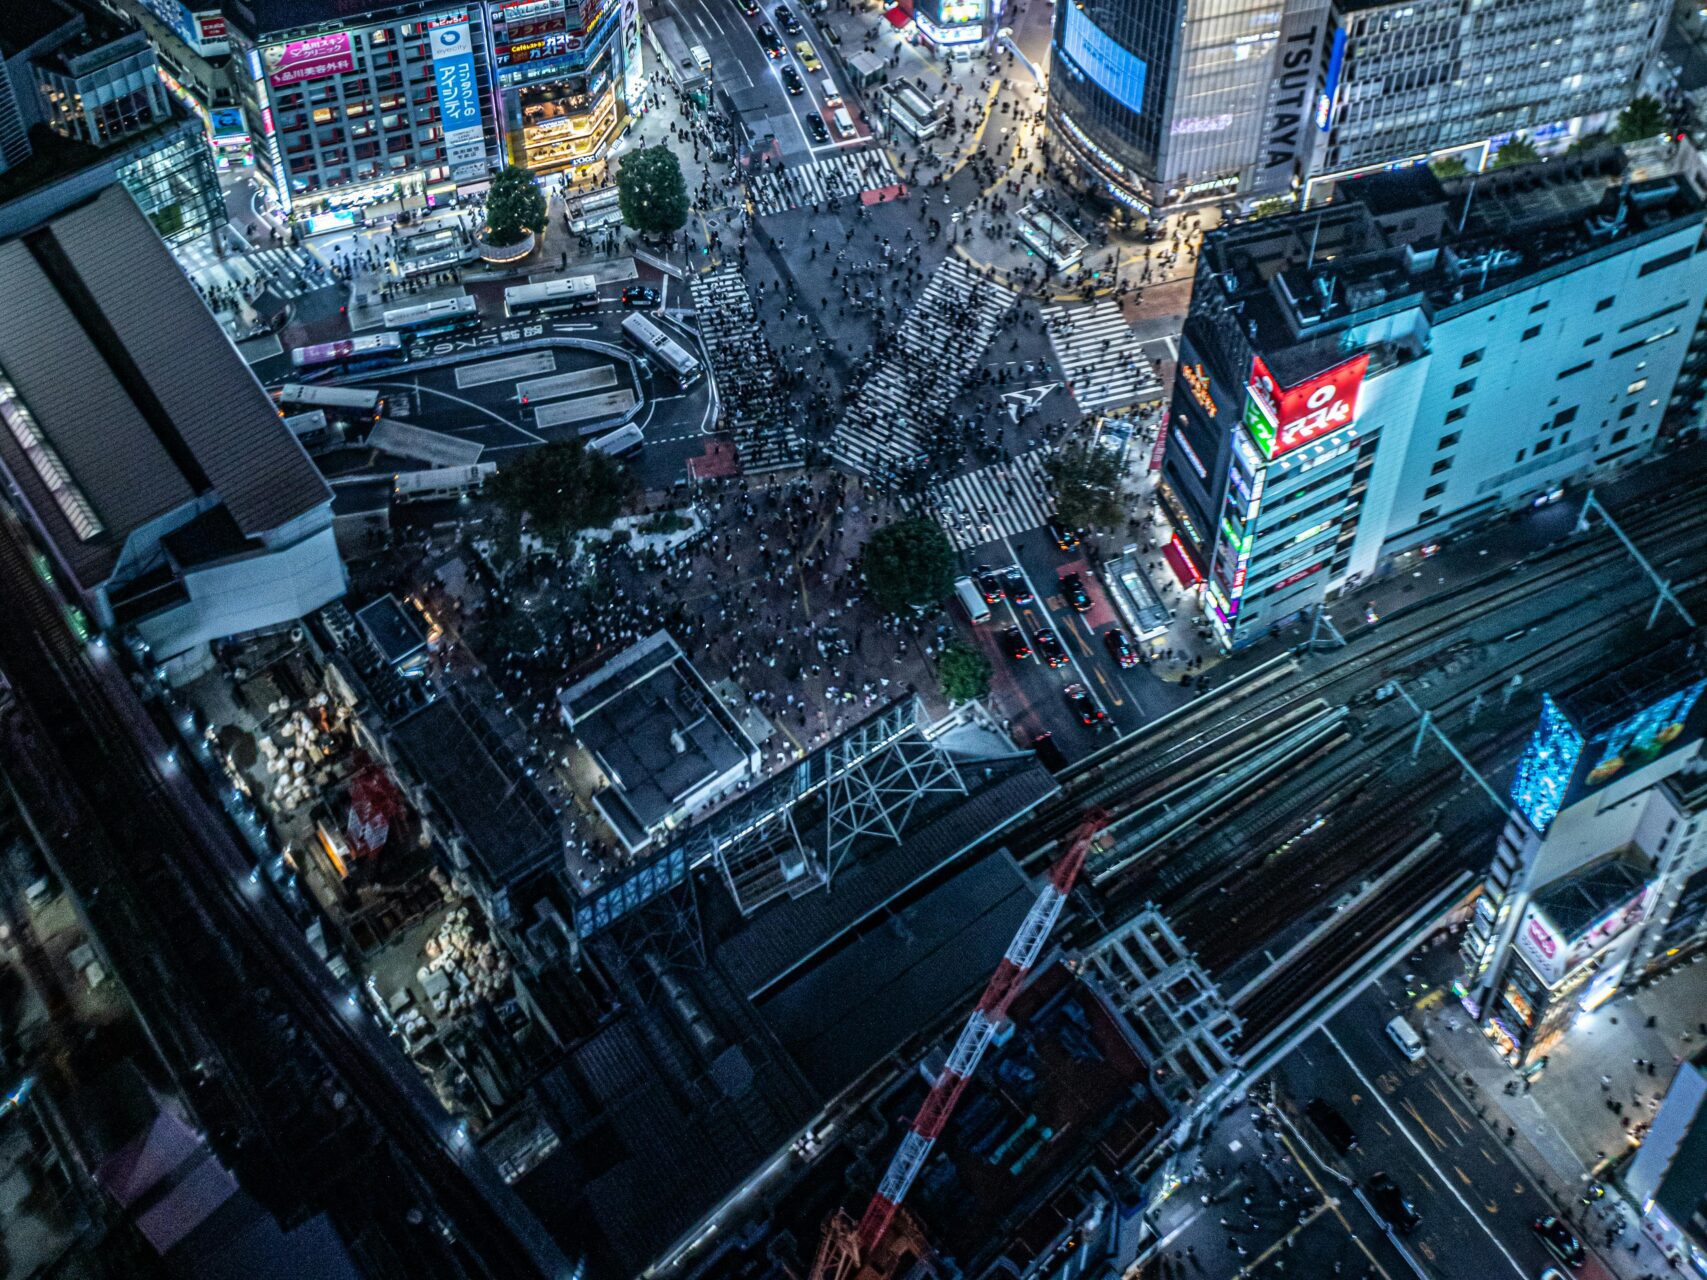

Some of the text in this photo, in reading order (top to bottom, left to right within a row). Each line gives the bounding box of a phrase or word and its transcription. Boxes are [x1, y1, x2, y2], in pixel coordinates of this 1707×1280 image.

[547, 34, 574, 46] ガスト
[439, 66, 461, 118] アイシティ
[458, 63, 476, 116] コンタクトの
[1265, 24, 1318, 169] TSUTAYA
[1108, 182, 1150, 216] TSUTAYA
[1184, 176, 1240, 193] TSUTAYA
